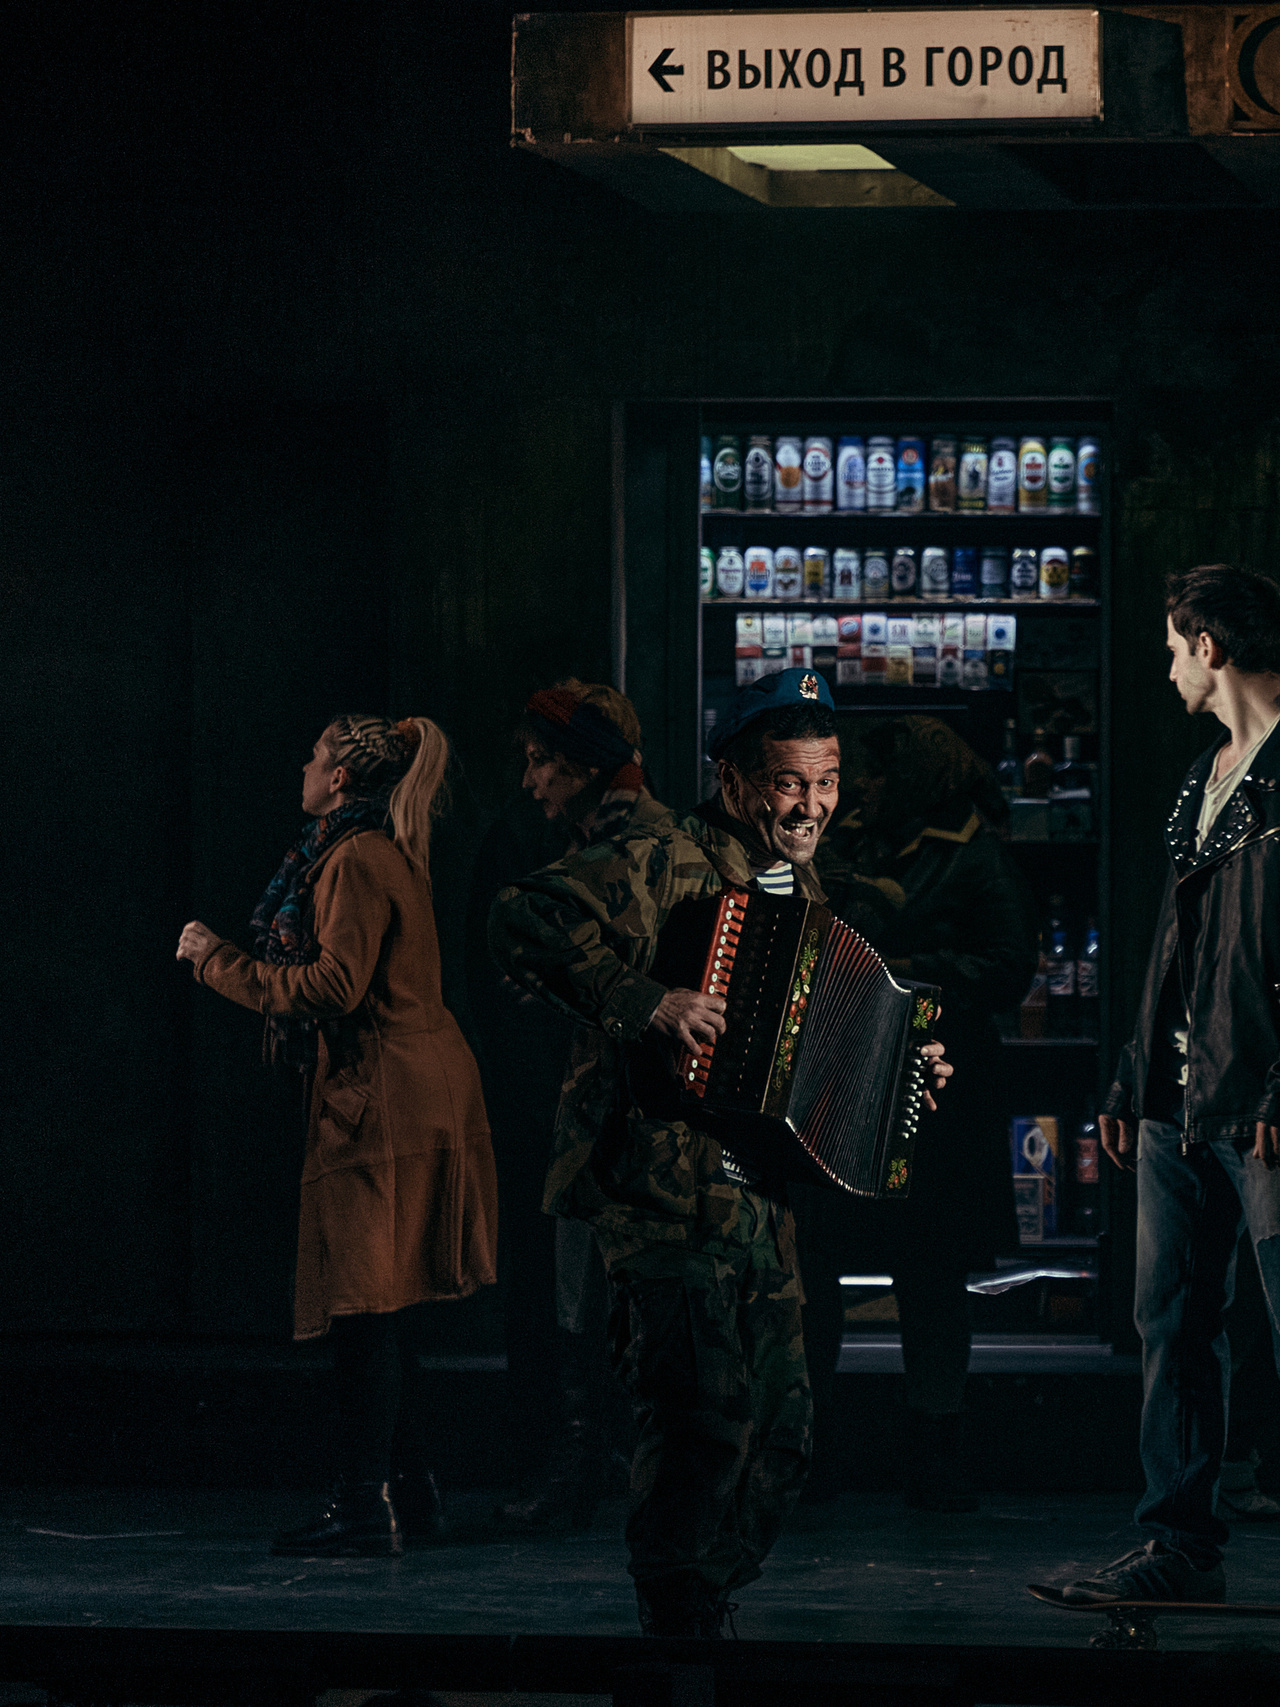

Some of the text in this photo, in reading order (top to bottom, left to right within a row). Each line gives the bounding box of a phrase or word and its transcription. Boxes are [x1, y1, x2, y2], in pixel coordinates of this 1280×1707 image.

[706, 45, 1067, 96] ВЫХОД В ГОРОД
